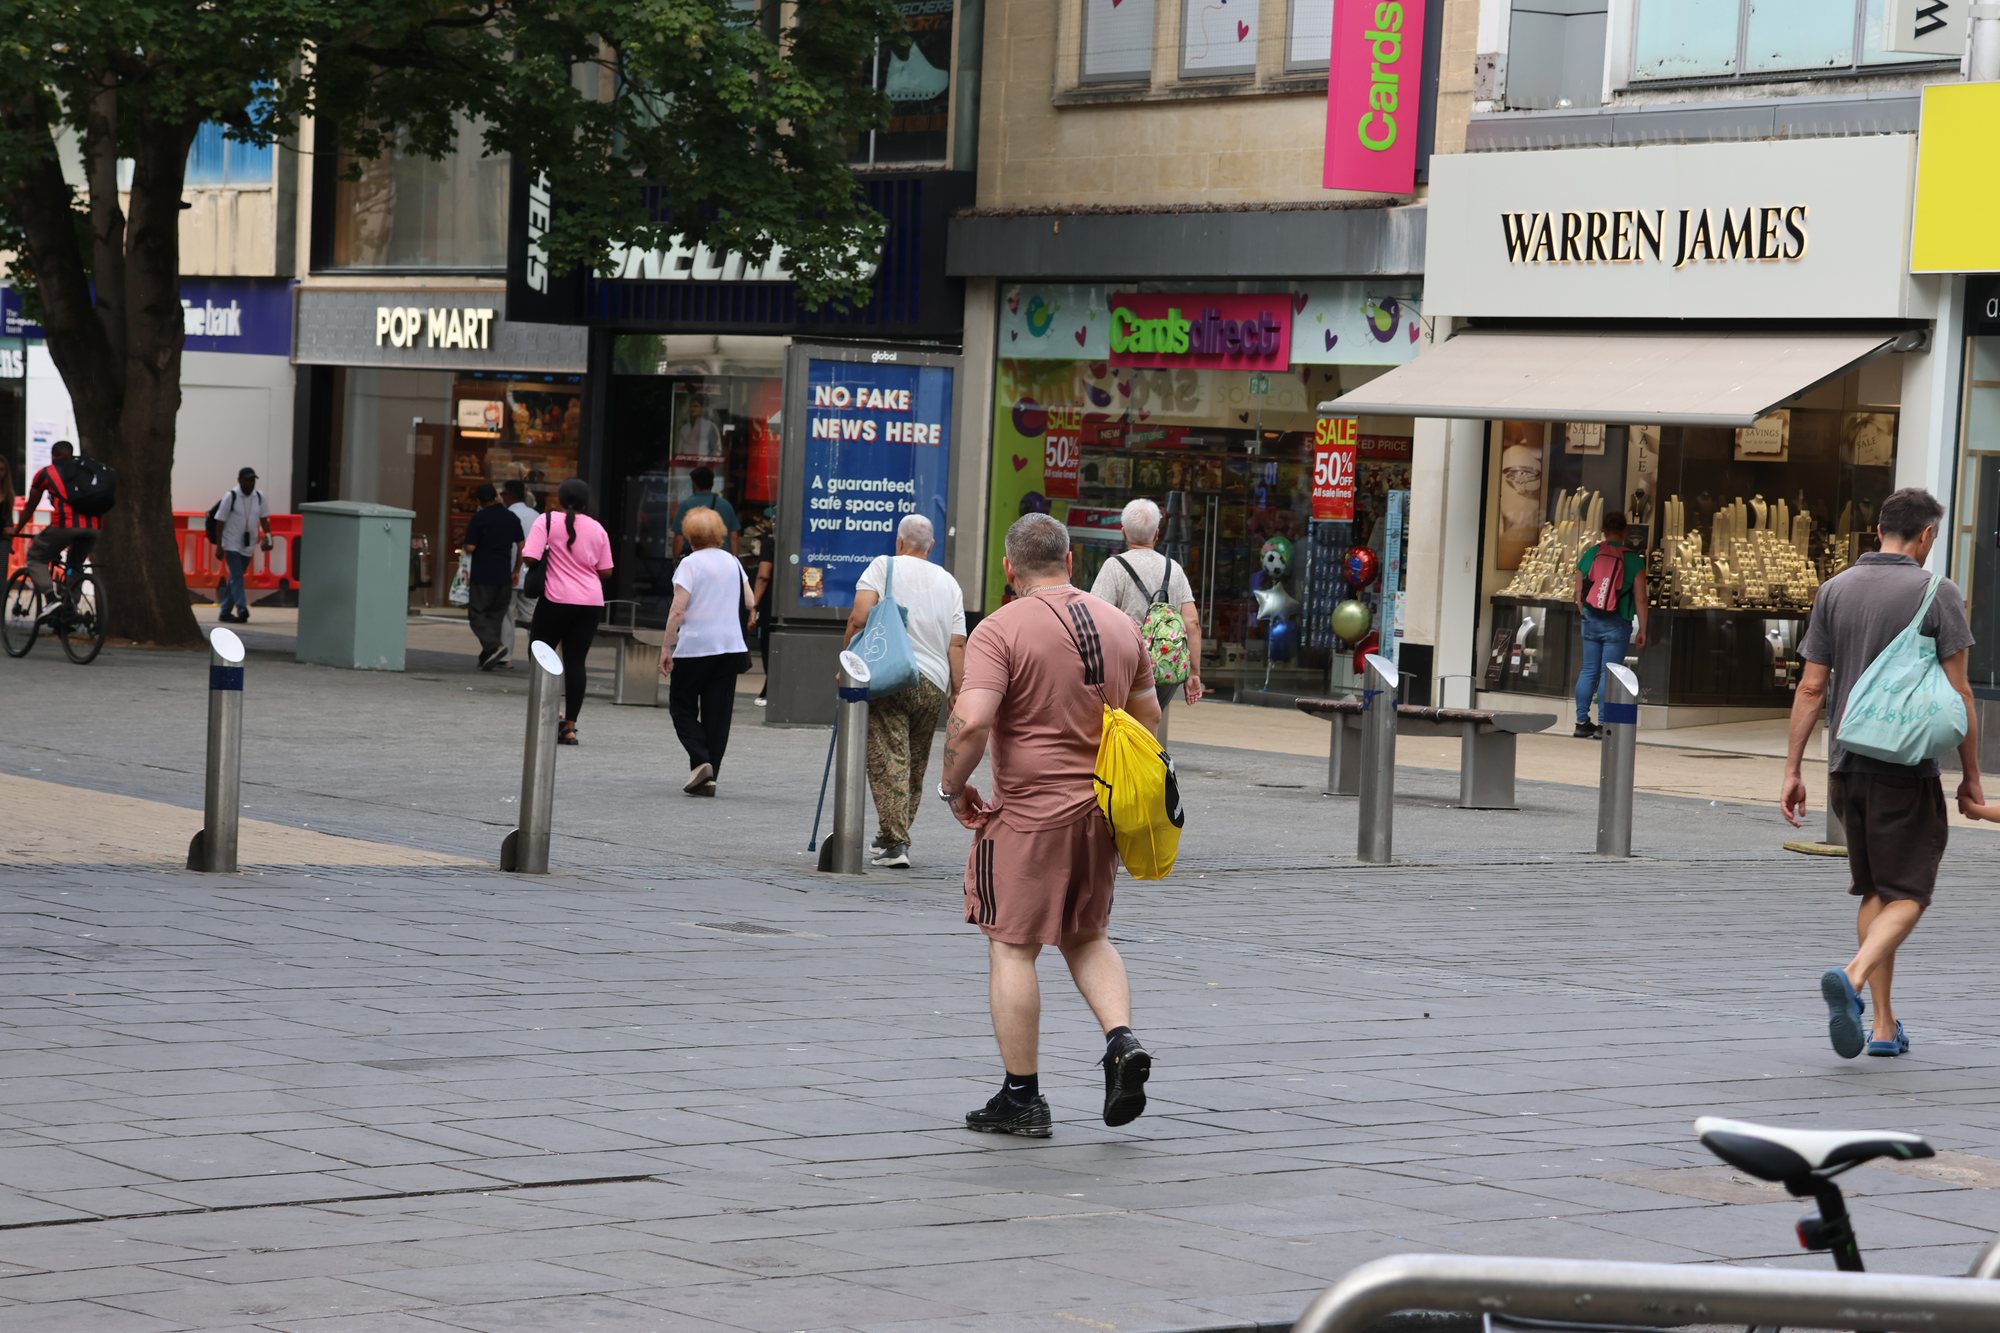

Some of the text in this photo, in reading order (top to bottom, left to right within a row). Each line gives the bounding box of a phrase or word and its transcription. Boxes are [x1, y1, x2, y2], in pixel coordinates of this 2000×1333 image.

[1501, 205, 1807, 268] WARREN JAMES
[206, 299, 241, 336] bank
[1986, 297, 2000, 318] a
[376, 306, 493, 349] POP MART
[871, 350, 897, 363] global
[814, 386, 911, 411] NO FAKE
[1047, 405, 1082, 430] SALE
[812, 418, 942, 445] NEWS HERE
[1101, 429, 1120, 439] NEW
[1315, 418, 1357, 445] SALE
[1572, 423, 1598, 435] SALE
[1745, 429, 1780, 438] SAVINGS
[1046, 436, 1079, 467] 50%
[1378, 440, 1407, 451] PRICE
[1314, 452, 1353, 486] 50%
[811, 475, 915, 494] A guaranteed
[1340, 476, 1353, 486] OFF
[1313, 488, 1352, 498] All sale lines
[810, 496, 916, 514] safe space for
[810, 517, 893, 532] your brand
[1597, 577, 1610, 608] adidas
